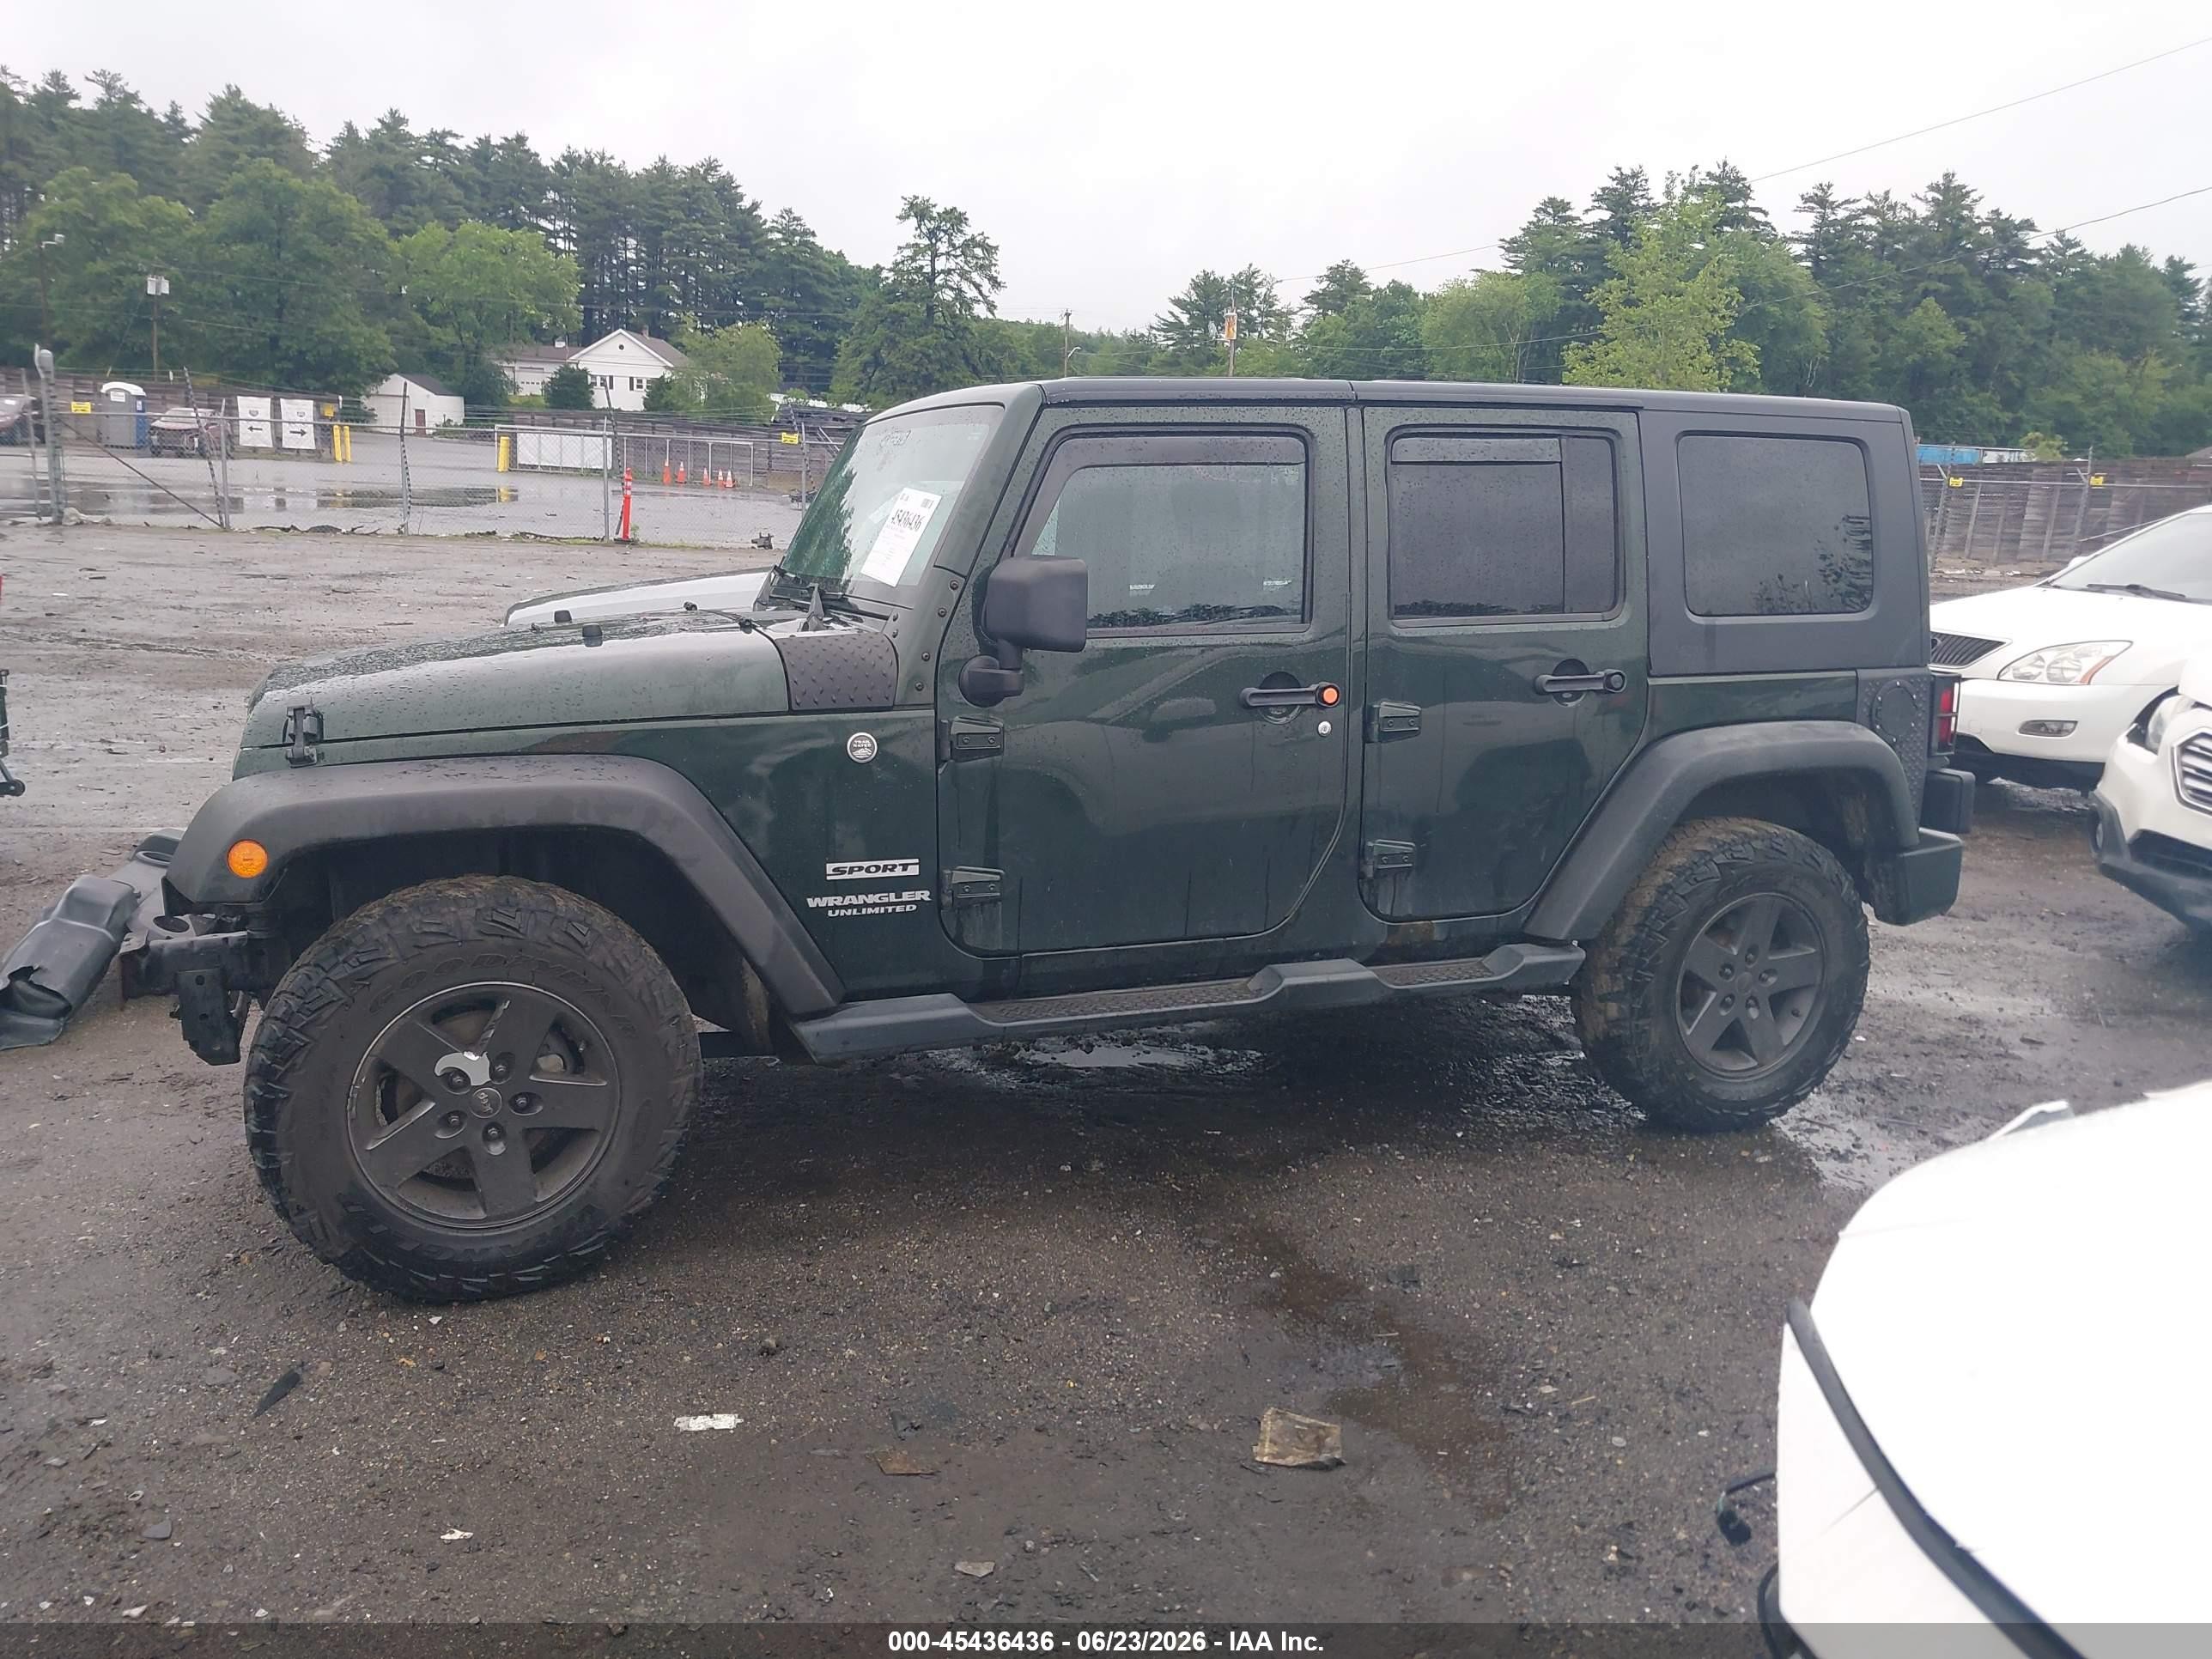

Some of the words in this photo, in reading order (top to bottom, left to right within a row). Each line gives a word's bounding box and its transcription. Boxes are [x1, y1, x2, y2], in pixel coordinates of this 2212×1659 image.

[831, 863, 911, 876] SPORT
[806, 890, 932, 908] WRANGLER
[827, 904, 917, 917] UNLIMITED
